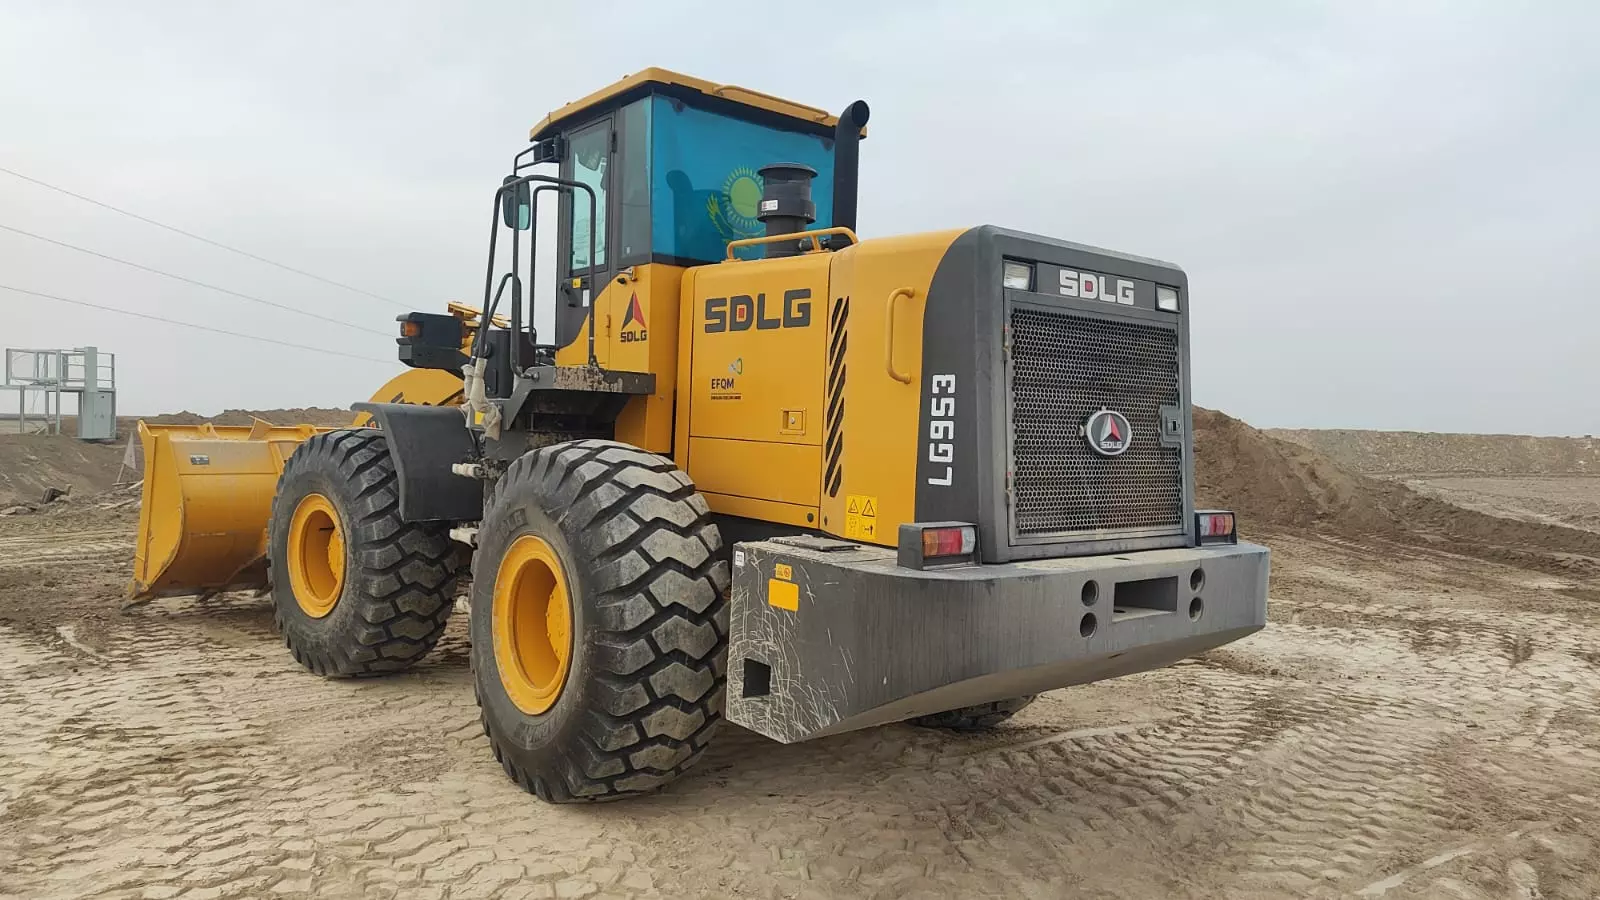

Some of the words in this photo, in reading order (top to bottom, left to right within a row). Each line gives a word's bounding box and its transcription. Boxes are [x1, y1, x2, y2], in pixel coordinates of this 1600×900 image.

[1059, 269, 1135, 306] SDLG
[704, 288, 812, 334] SDLG
[620, 329, 648, 343] SDLG
[711, 378, 735, 390] EFQM
[928, 374, 956, 486] LG953
